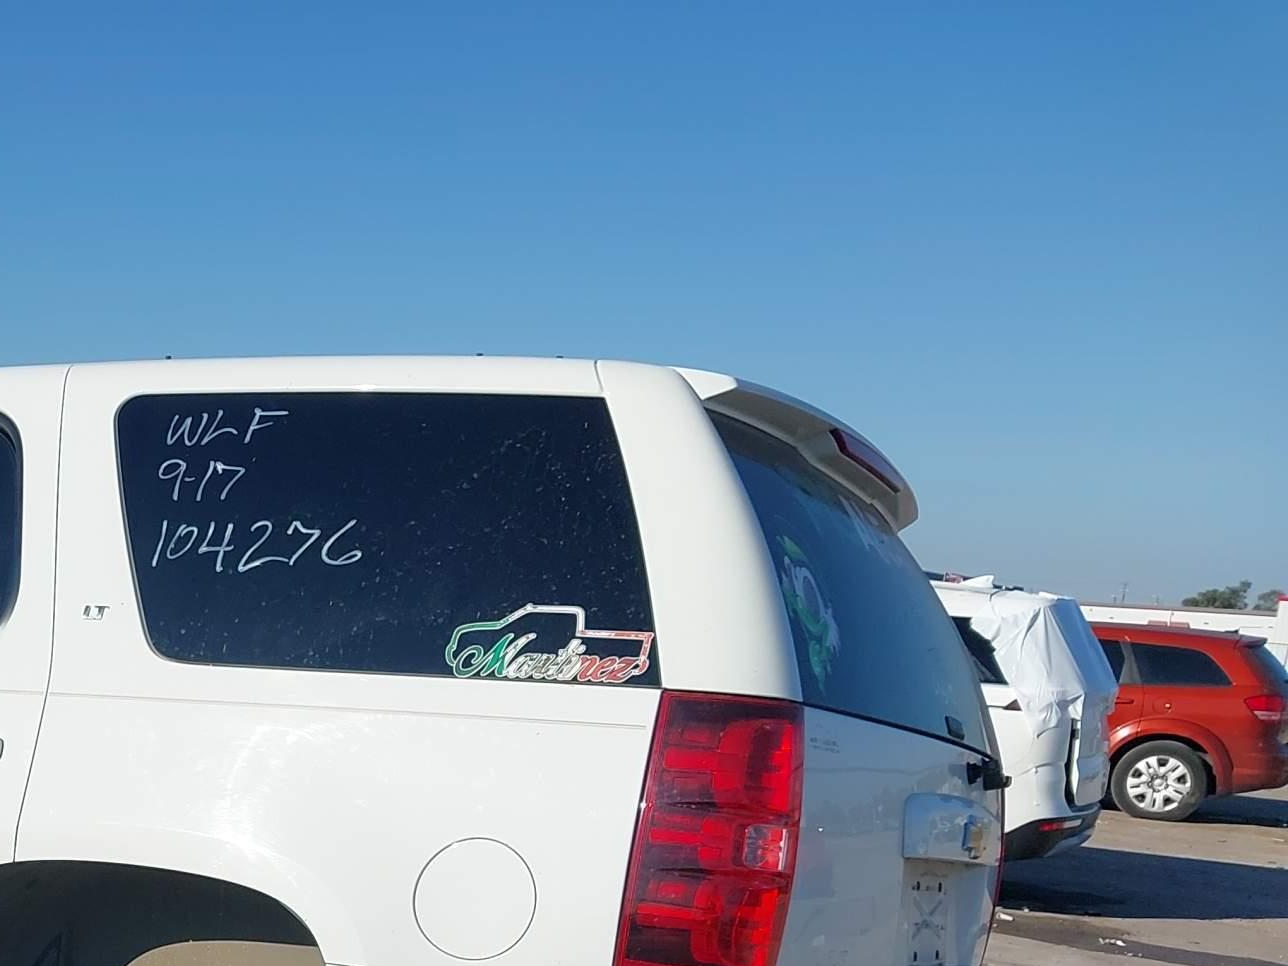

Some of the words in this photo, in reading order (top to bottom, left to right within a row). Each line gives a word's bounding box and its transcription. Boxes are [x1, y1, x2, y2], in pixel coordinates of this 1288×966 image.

[158, 459, 246, 501] 9-17
[151, 519, 362, 573] 104276
[82, 604, 111, 621] LT
